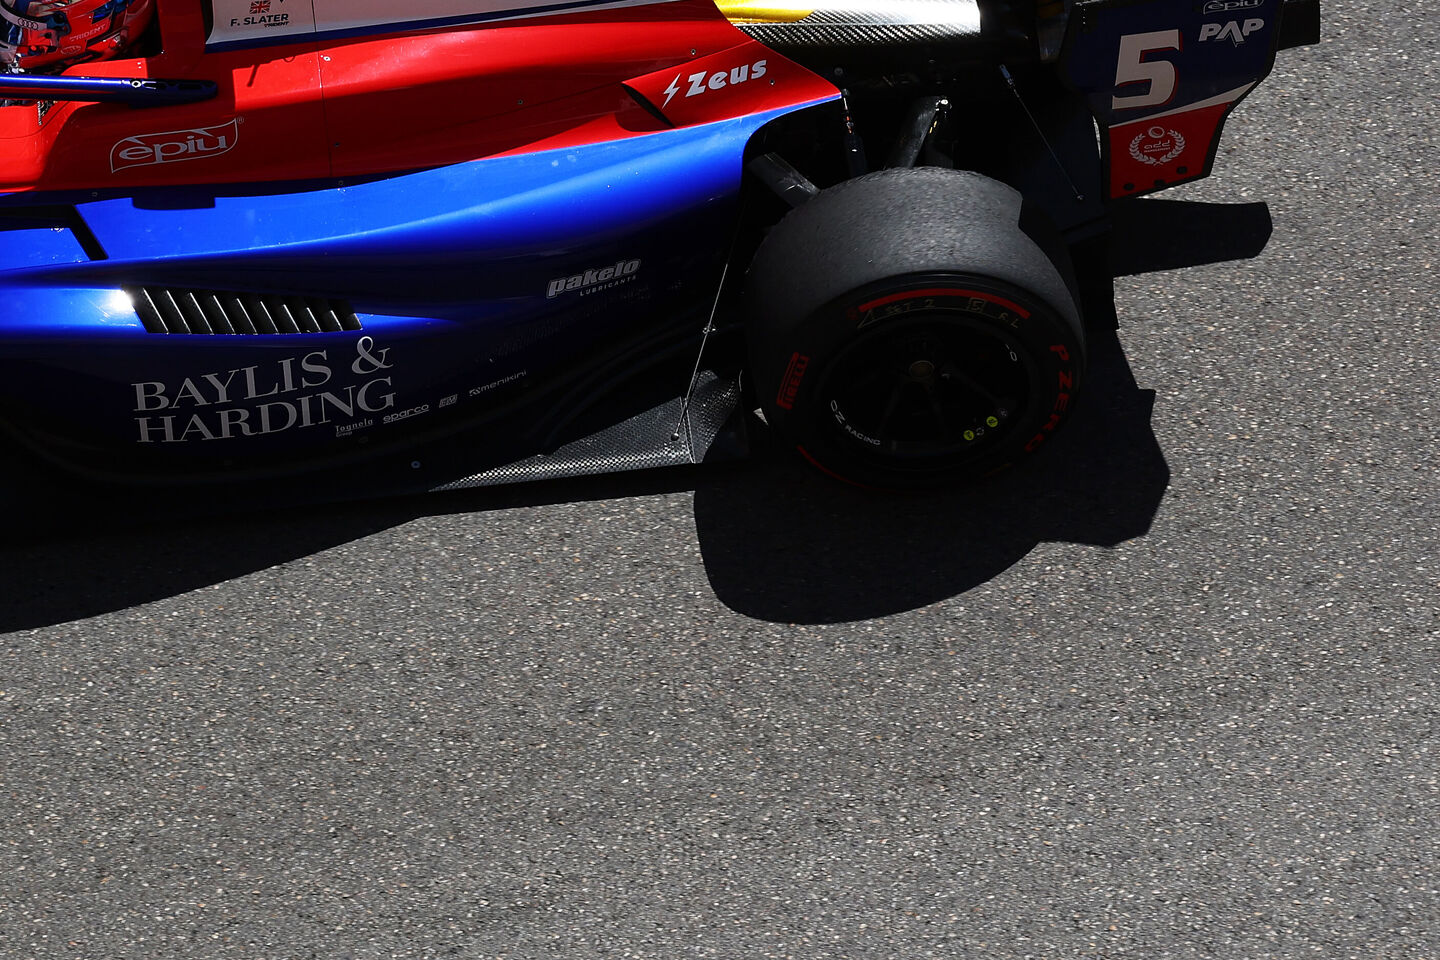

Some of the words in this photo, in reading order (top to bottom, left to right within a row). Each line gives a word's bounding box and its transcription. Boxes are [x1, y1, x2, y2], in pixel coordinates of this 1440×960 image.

[231, 19, 241, 27] F.
[243, 13, 289, 26] SLATER
[1198, 18, 1265, 47] PAP
[685, 59, 767, 98] Zeus
[1111, 28, 1184, 110] 5
[546, 258, 641, 299] pakelo
[130, 349, 331, 412] BAYLIS
[351, 336, 395, 375] &
[776, 351, 811, 411] PIRELLI
[133, 376, 397, 444] HARDING
[383, 404, 430, 423] sparco
[830, 400, 847, 425] OZ
